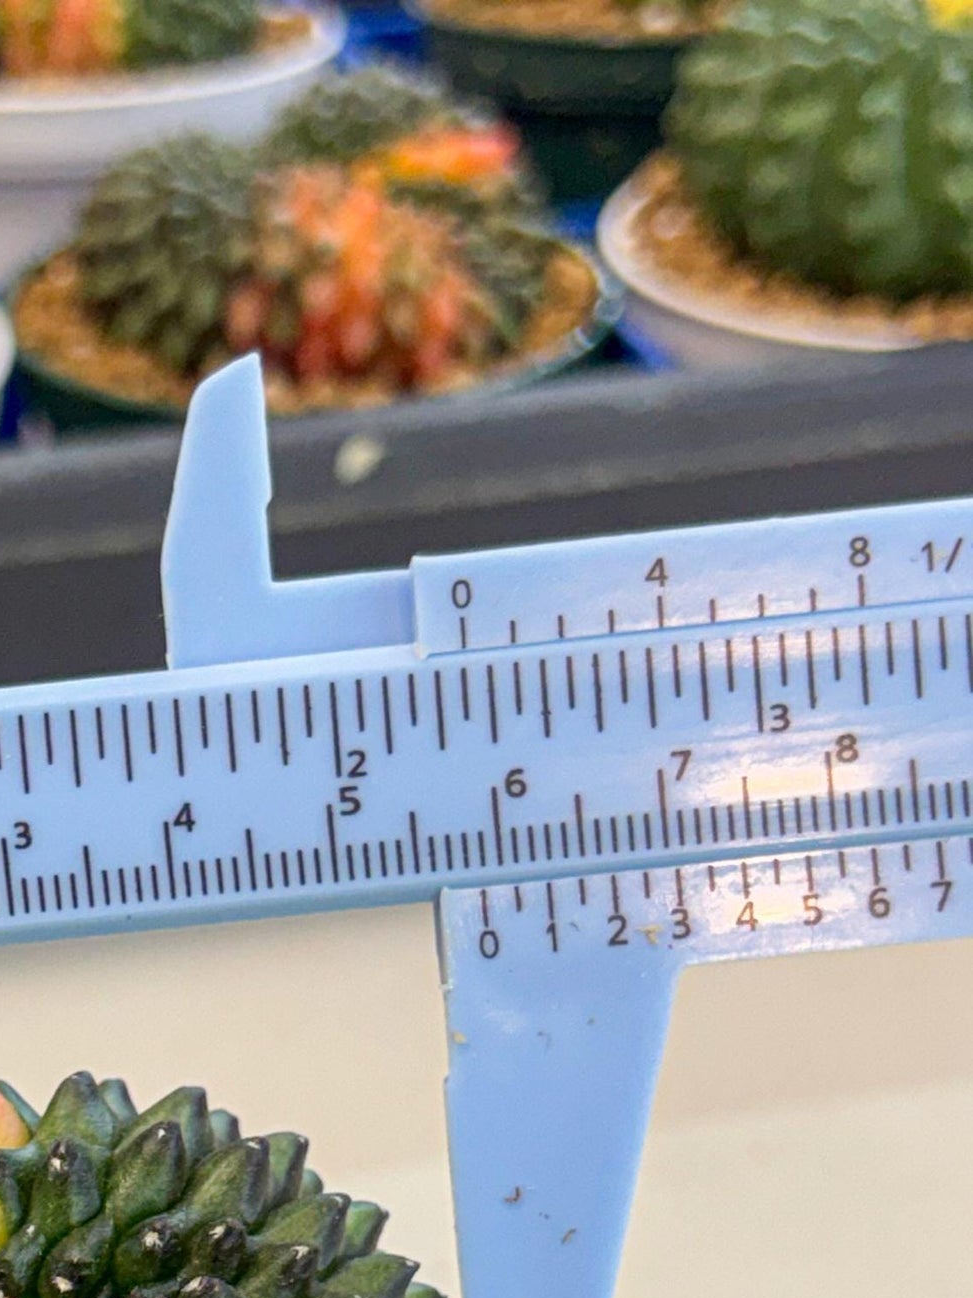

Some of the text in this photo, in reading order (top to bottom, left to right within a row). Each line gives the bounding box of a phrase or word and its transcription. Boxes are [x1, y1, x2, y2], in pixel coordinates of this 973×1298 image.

[450, 579, 473, 609] 0
[645, 557, 669, 587] 4
[848, 537, 871, 567] 8
[346, 750, 368, 778] 2
[770, 704, 790, 732] 3
[13, 823, 33, 850] 3
[173, 803, 196, 832] 4
[339, 787, 362, 816] 5
[503, 769, 528, 798] 6
[671, 750, 693, 782] 7
[835, 734, 859, 763] 8
[478, 882, 953, 959] 0 1 2 3 4 5 6 7
